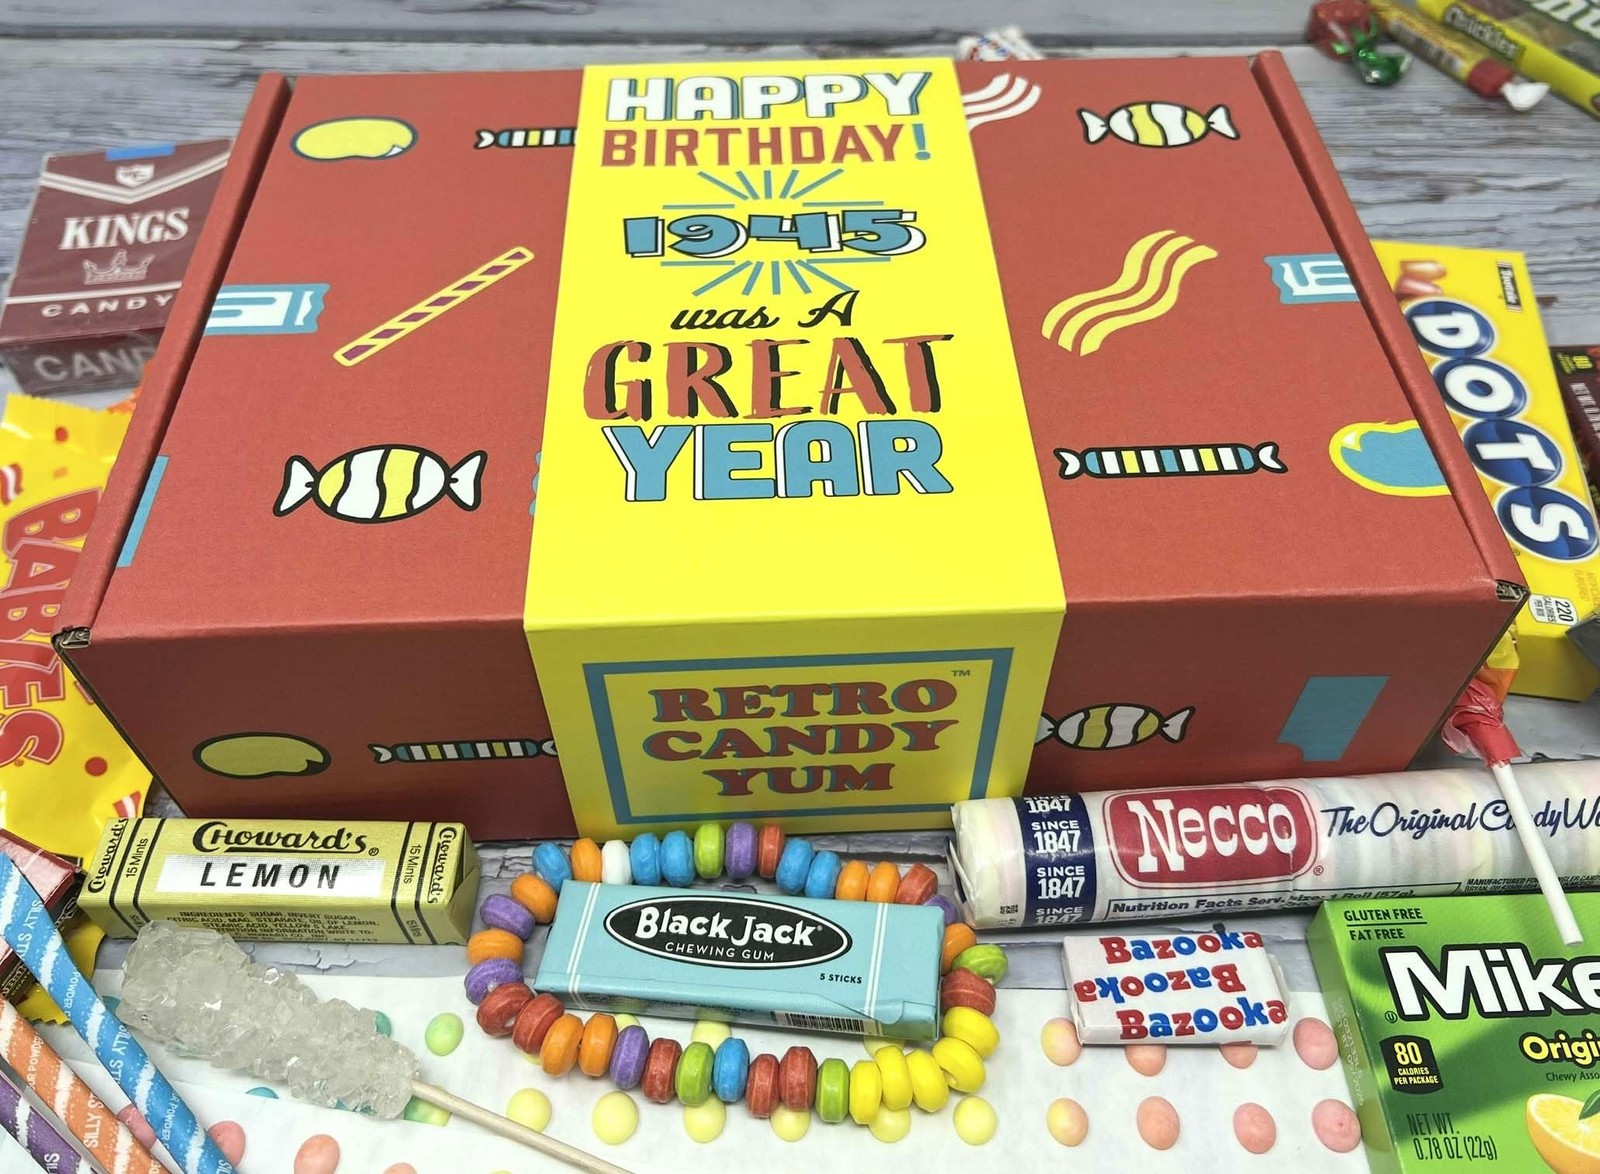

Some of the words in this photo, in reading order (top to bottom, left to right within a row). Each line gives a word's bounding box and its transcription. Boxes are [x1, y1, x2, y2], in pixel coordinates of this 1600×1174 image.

[605, 71, 931, 122] HAPPY
[600, 122, 931, 168] BIRTHDAY!
[58, 206, 190, 250] KINGS
[622, 209, 927, 258] 1945
[41, 294, 174, 318] CANDY
[669, 306, 780, 331] was
[798, 290, 861, 328] A
[582, 333, 955, 422] GREAT
[1410, 308, 1592, 544] DOTS
[602, 420, 955, 502] YEAR
[1555, 600, 1574, 622] 220
[648, 678, 957, 722] RETRO
[642, 719, 960, 762] CANDY
[702, 762, 897, 797] YUM
[1025, 798, 1072, 813] 1847
[1320, 805, 1370, 838] The
[1369, 801, 1479, 840] Original
[1479, 799, 1565, 838] Cady
[1031, 820, 1080, 831] SINCE
[1127, 798, 1297, 873] Necco
[131, 838, 149, 866] Mints
[409, 844, 422, 855] 15
[1033, 830, 1081, 854] 1847
[126, 866, 138, 878] 15
[199, 861, 341, 890] LEMON
[403, 856, 419, 884] Mints
[1036, 865, 1085, 878] SINCE
[1037, 877, 1086, 900] 1847
[1034, 914, 1083, 925] 1847
[1035, 906, 1084, 916] SINCE
[1112, 901, 1189, 913] Nutrition
[1194, 899, 1242, 909] Facts
[1344, 908, 1391, 922] GLUTEN
[1392, 907, 1424, 920] FREE
[634, 905, 732, 939] Black
[1349, 929, 1372, 941] FAT
[1373, 928, 1406, 940] FREE
[664, 941, 737, 959] CHEWING
[741, 948, 775, 962] GUM
[1098, 930, 1265, 965] Bazooka
[63, 970, 81, 1009] POWDER
[819, 972, 827, 982] 5
[828, 973, 863, 985] STICKS
[1073, 963, 1247, 1004] Bazooka
[1380, 944, 1600, 1020] Mike
[1116, 997, 1288, 1040] Bazooka
[1394, 1041, 1423, 1066] 80
[1522, 1031, 1600, 1066] Origi
[1394, 1076, 1407, 1085] PER
[1408, 1075, 1439, 1085] PACKAGE
[1398, 1067, 1430, 1076] CALORIES
[1545, 1072, 1577, 1083] Chewy
[1580, 1071, 1600, 1080] Asso
[83, 1111, 103, 1149] SILLY
[161, 1101, 179, 1141] POWDER
[1405, 1112, 1430, 1136] NET
[1433, 1112, 1460, 1136] WT.
[1413, 1137, 1442, 1161] 0.78
[1443, 1136, 1462, 1160] OZ
[1463, 1135, 1498, 1161] (22g)
